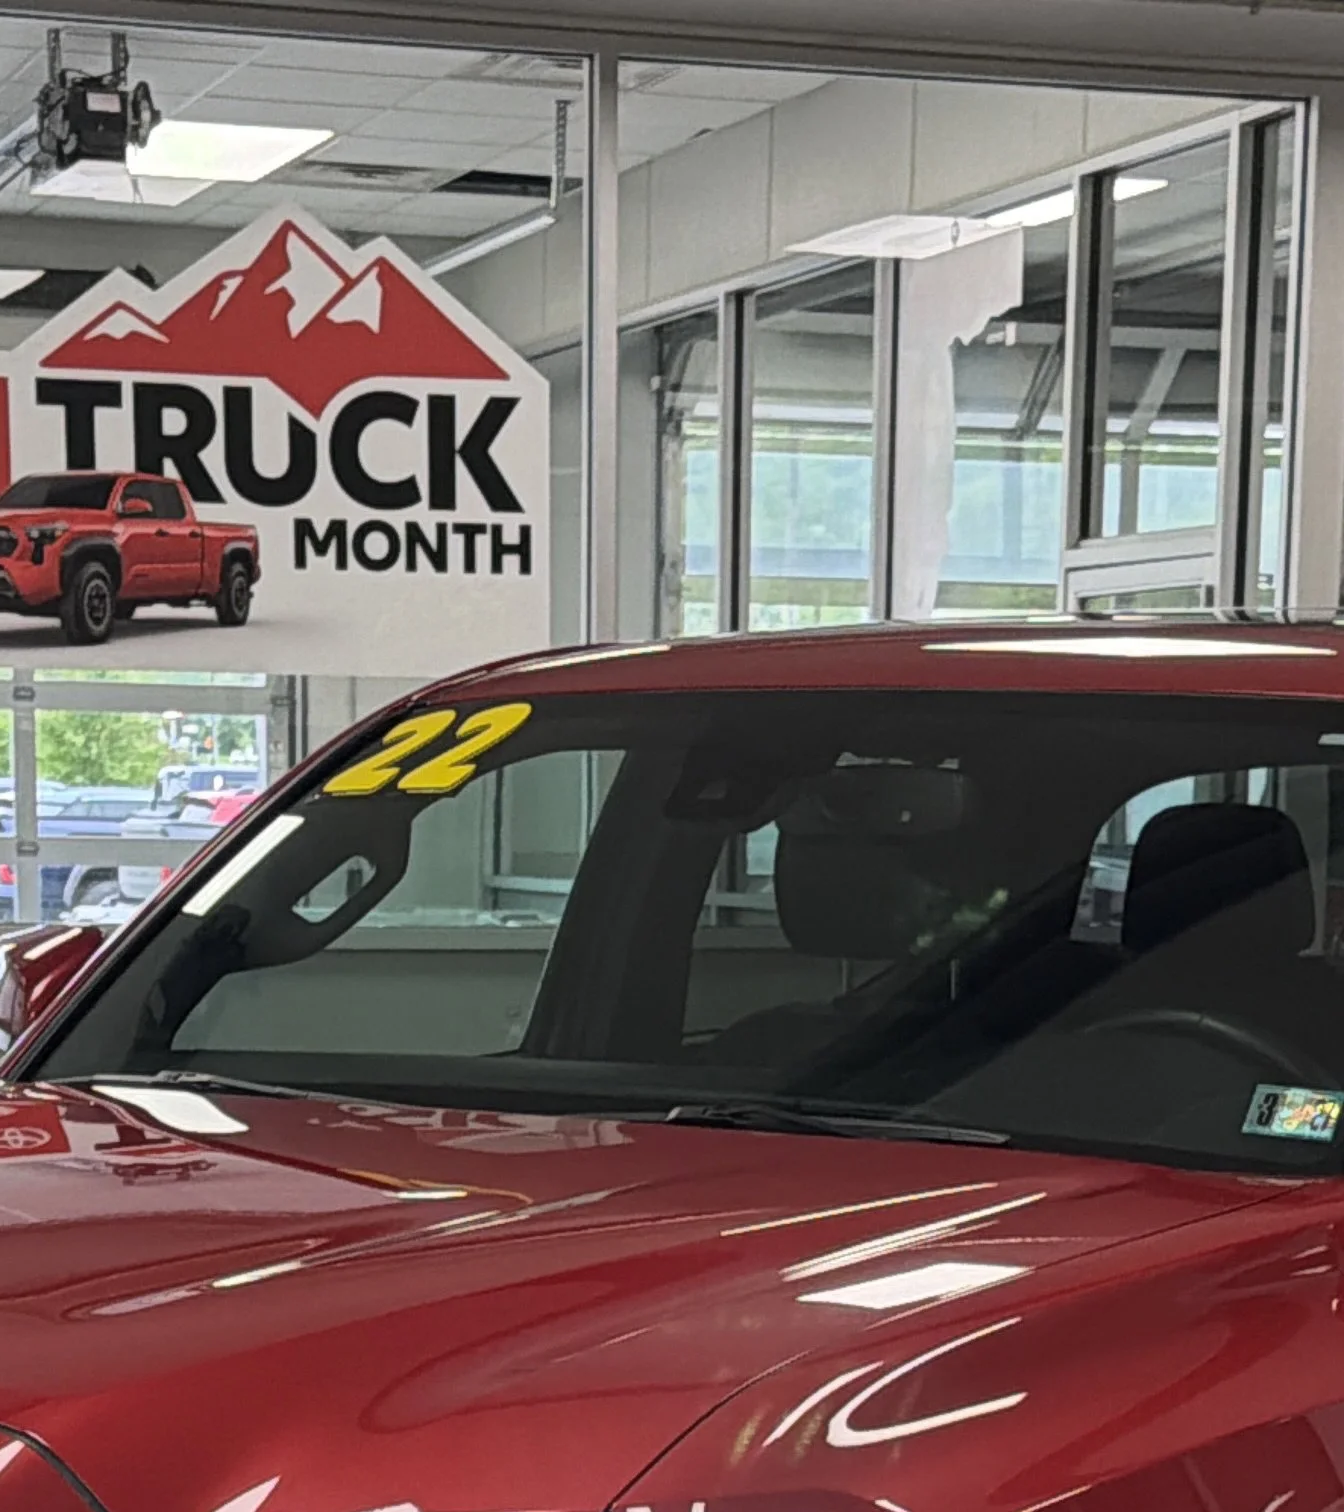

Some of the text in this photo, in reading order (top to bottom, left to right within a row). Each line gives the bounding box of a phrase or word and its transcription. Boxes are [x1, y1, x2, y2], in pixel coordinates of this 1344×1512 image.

[35, 376, 525, 513] TRUCK
[293, 517, 532, 576] MONTH
[322, 702, 533, 796] 22
